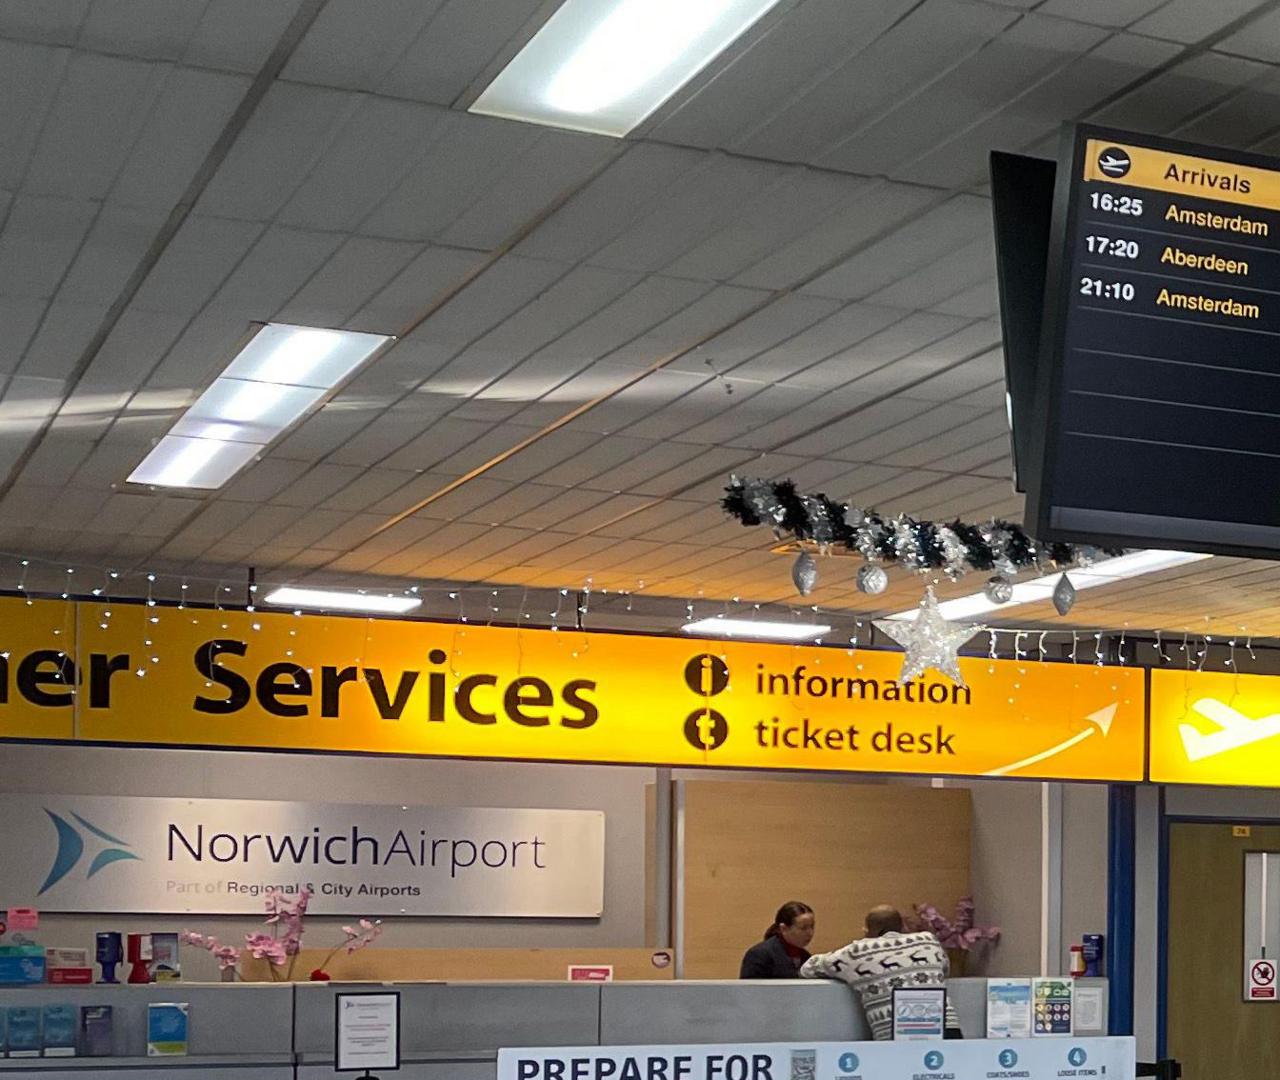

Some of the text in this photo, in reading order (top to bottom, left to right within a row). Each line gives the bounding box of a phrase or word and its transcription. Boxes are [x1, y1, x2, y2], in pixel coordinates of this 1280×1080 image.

[1164, 163, 1251, 194] Arrivals
[1090, 192, 1143, 216] 16:25
[1165, 205, 1268, 236] Amsterdam
[1086, 235, 1139, 259] 17:20
[1161, 247, 1248, 276] Aberdeen
[1080, 277, 1135, 301] 21:10
[1156, 289, 1259, 319] Amsterdam
[192, 639, 599, 730] Services
[756, 663, 971, 705] information
[754, 717, 955, 756] ticket desk
[167, 824, 547, 878] NorwichAirport
[166, 880, 421, 899] Part of Regional & City Airports
[912, 1073, 955, 1080] ELECTRICALS
[929, 1055, 938, 1066] 2
[1003, 1052, 1013, 1065] 3
